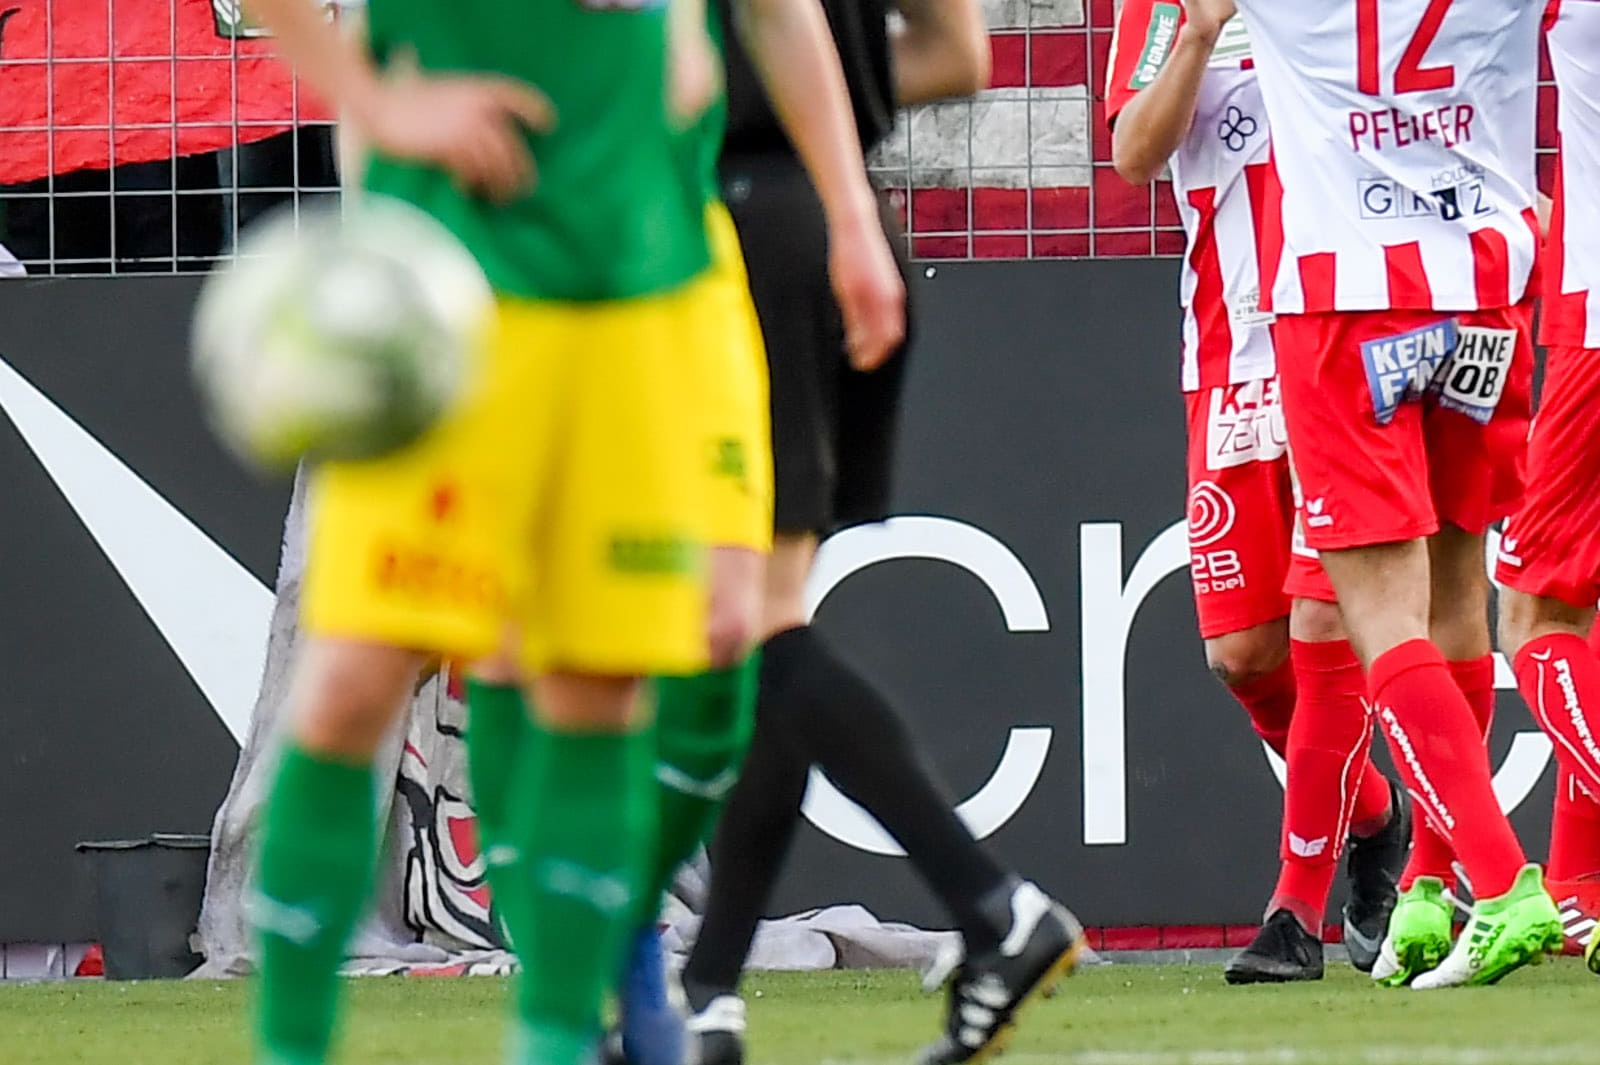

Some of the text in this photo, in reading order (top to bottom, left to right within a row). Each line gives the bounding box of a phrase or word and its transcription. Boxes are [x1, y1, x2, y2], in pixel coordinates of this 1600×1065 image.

[1349, 104, 1474, 153] PFEIFER
[1371, 327, 1511, 374] KEIN HNE
